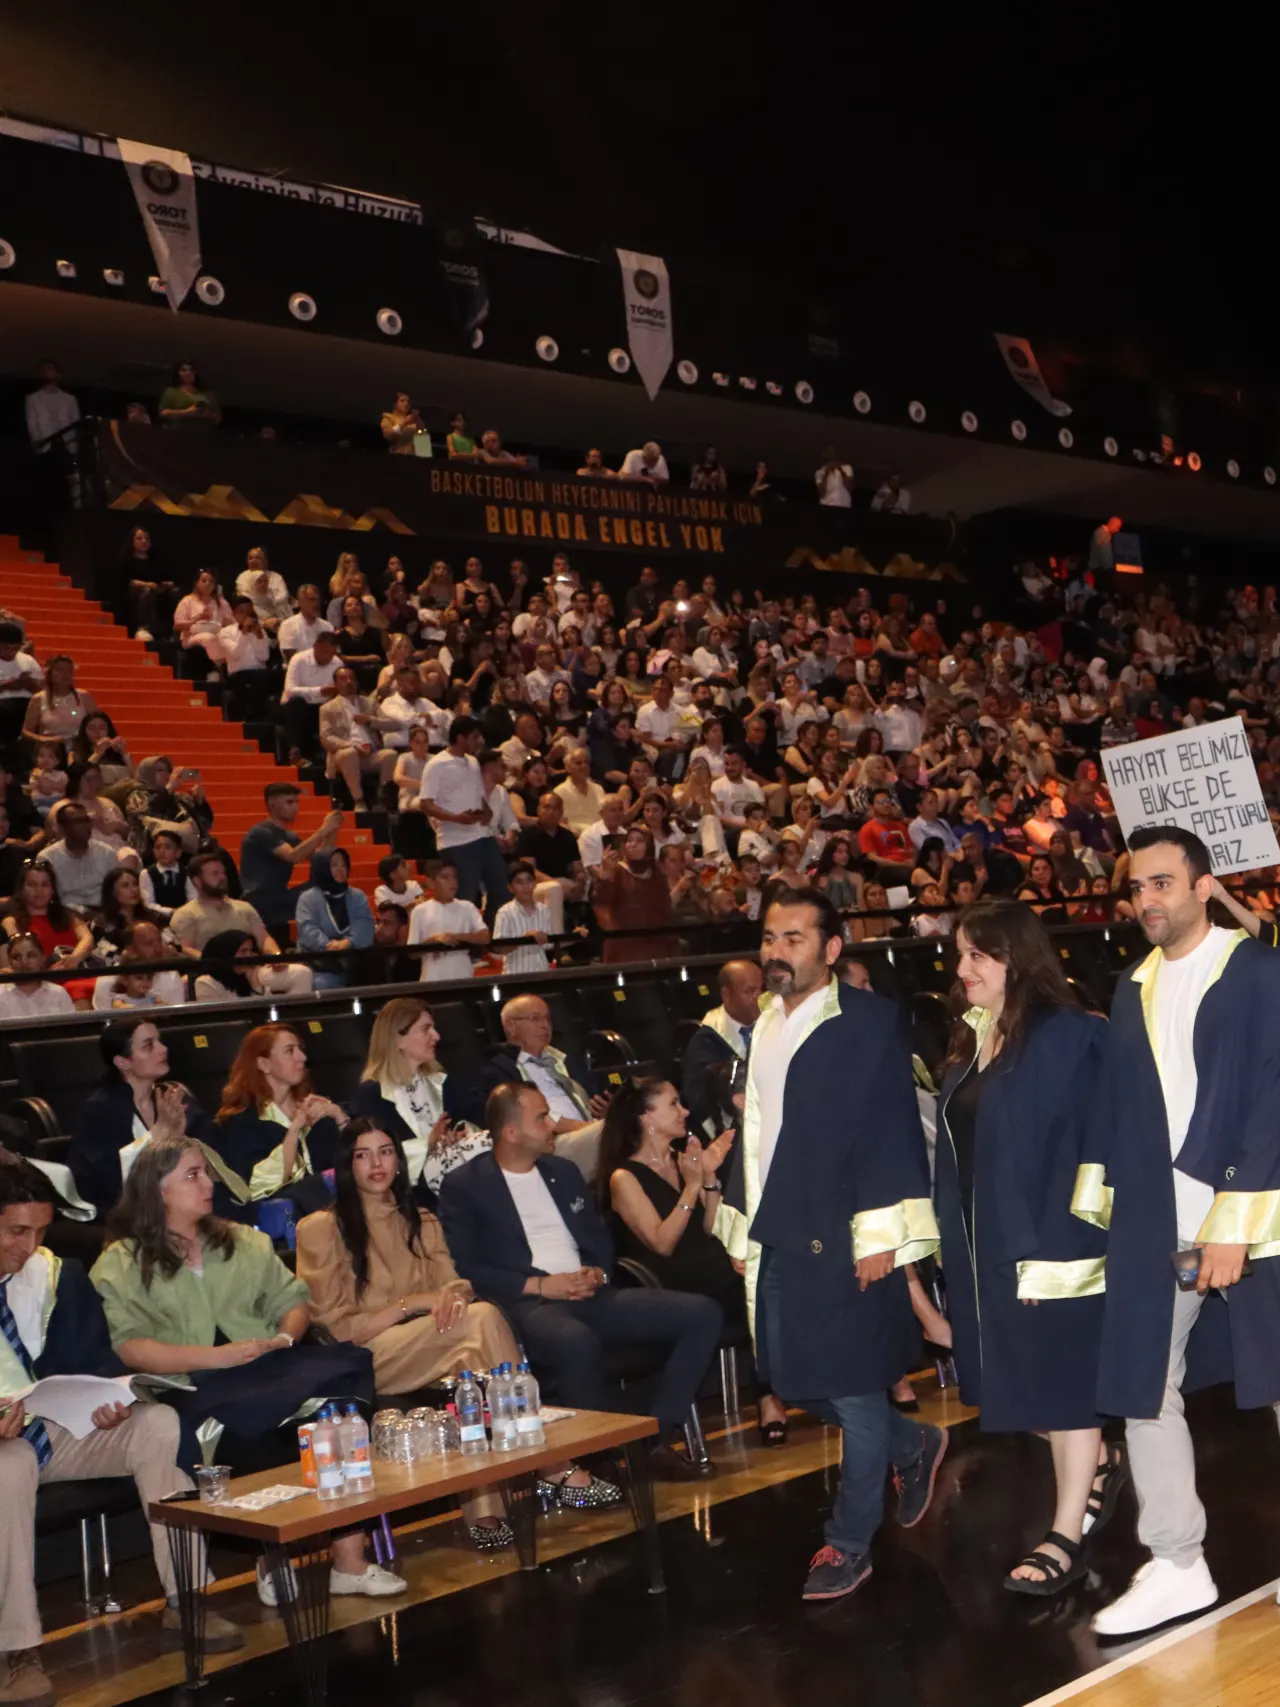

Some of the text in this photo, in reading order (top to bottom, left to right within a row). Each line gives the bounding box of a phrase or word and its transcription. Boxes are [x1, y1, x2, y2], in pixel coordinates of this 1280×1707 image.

[630, 304, 666, 320] TOROS
[430, 470, 545, 503] BASKETBOLUN
[647, 493, 728, 522] PAYLAŞMAK
[485, 504, 725, 553] BURADA ENGEL YOK
[1108, 748, 1168, 787] HAYAT
[1176, 730, 1250, 772] BELİMİZİ
[1205, 770, 1237, 801] DE
[1190, 800, 1269, 836] POSTÜRÜ
